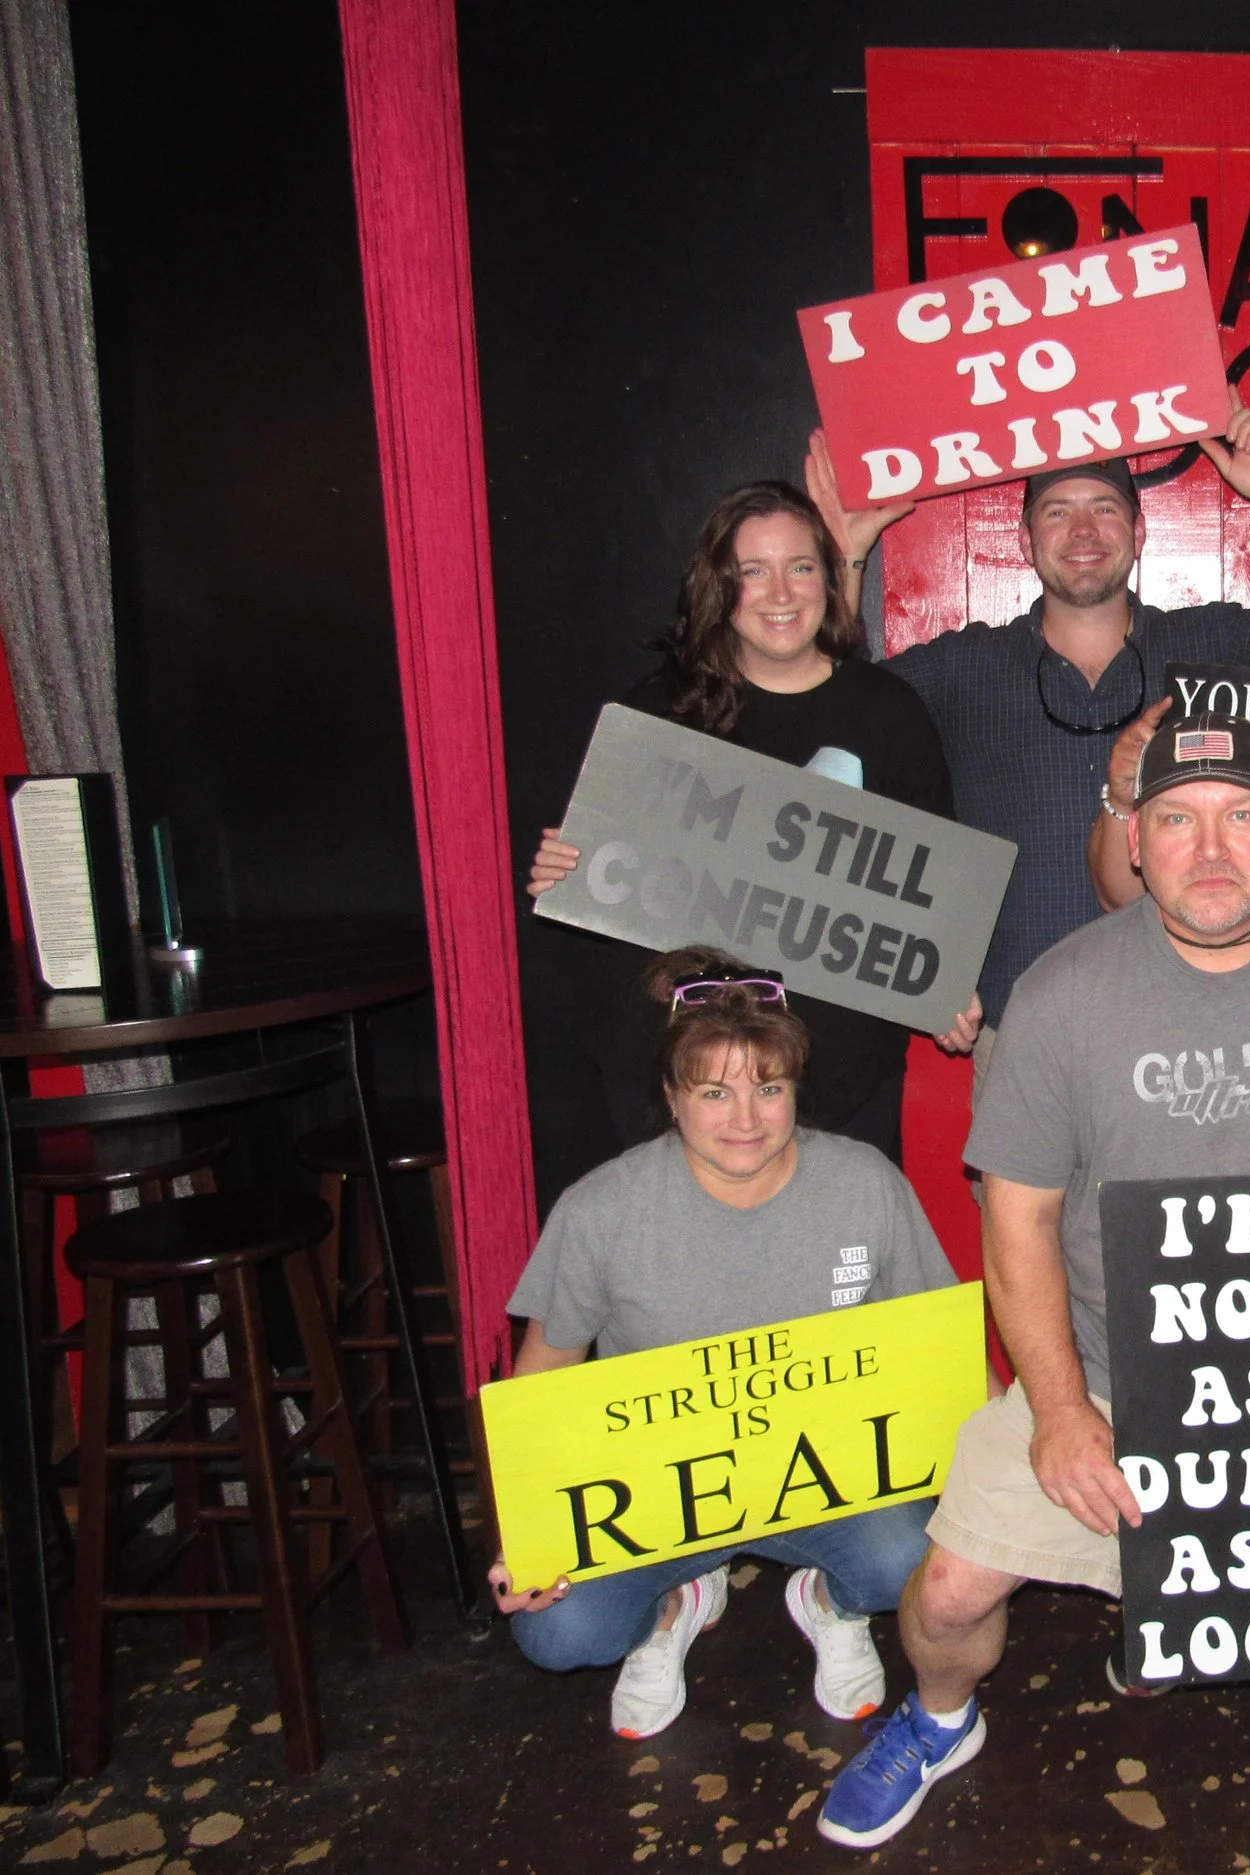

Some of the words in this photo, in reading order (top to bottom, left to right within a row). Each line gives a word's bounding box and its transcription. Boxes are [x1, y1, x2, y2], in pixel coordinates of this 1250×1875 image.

[823, 310, 865, 363] I
[897, 238, 1187, 343] CAME
[957, 340, 1077, 406] TO
[861, 385, 1209, 500] DRINK
[766, 801, 934, 910] STILL
[586, 840, 941, 997] CONFUSED
[840, 1246, 868, 1264] THE
[605, 1346, 880, 1434] STRUGGLE
[692, 1328, 794, 1378] THE
[729, 1405, 772, 1441] IS
[555, 1410, 938, 1575] REAL
